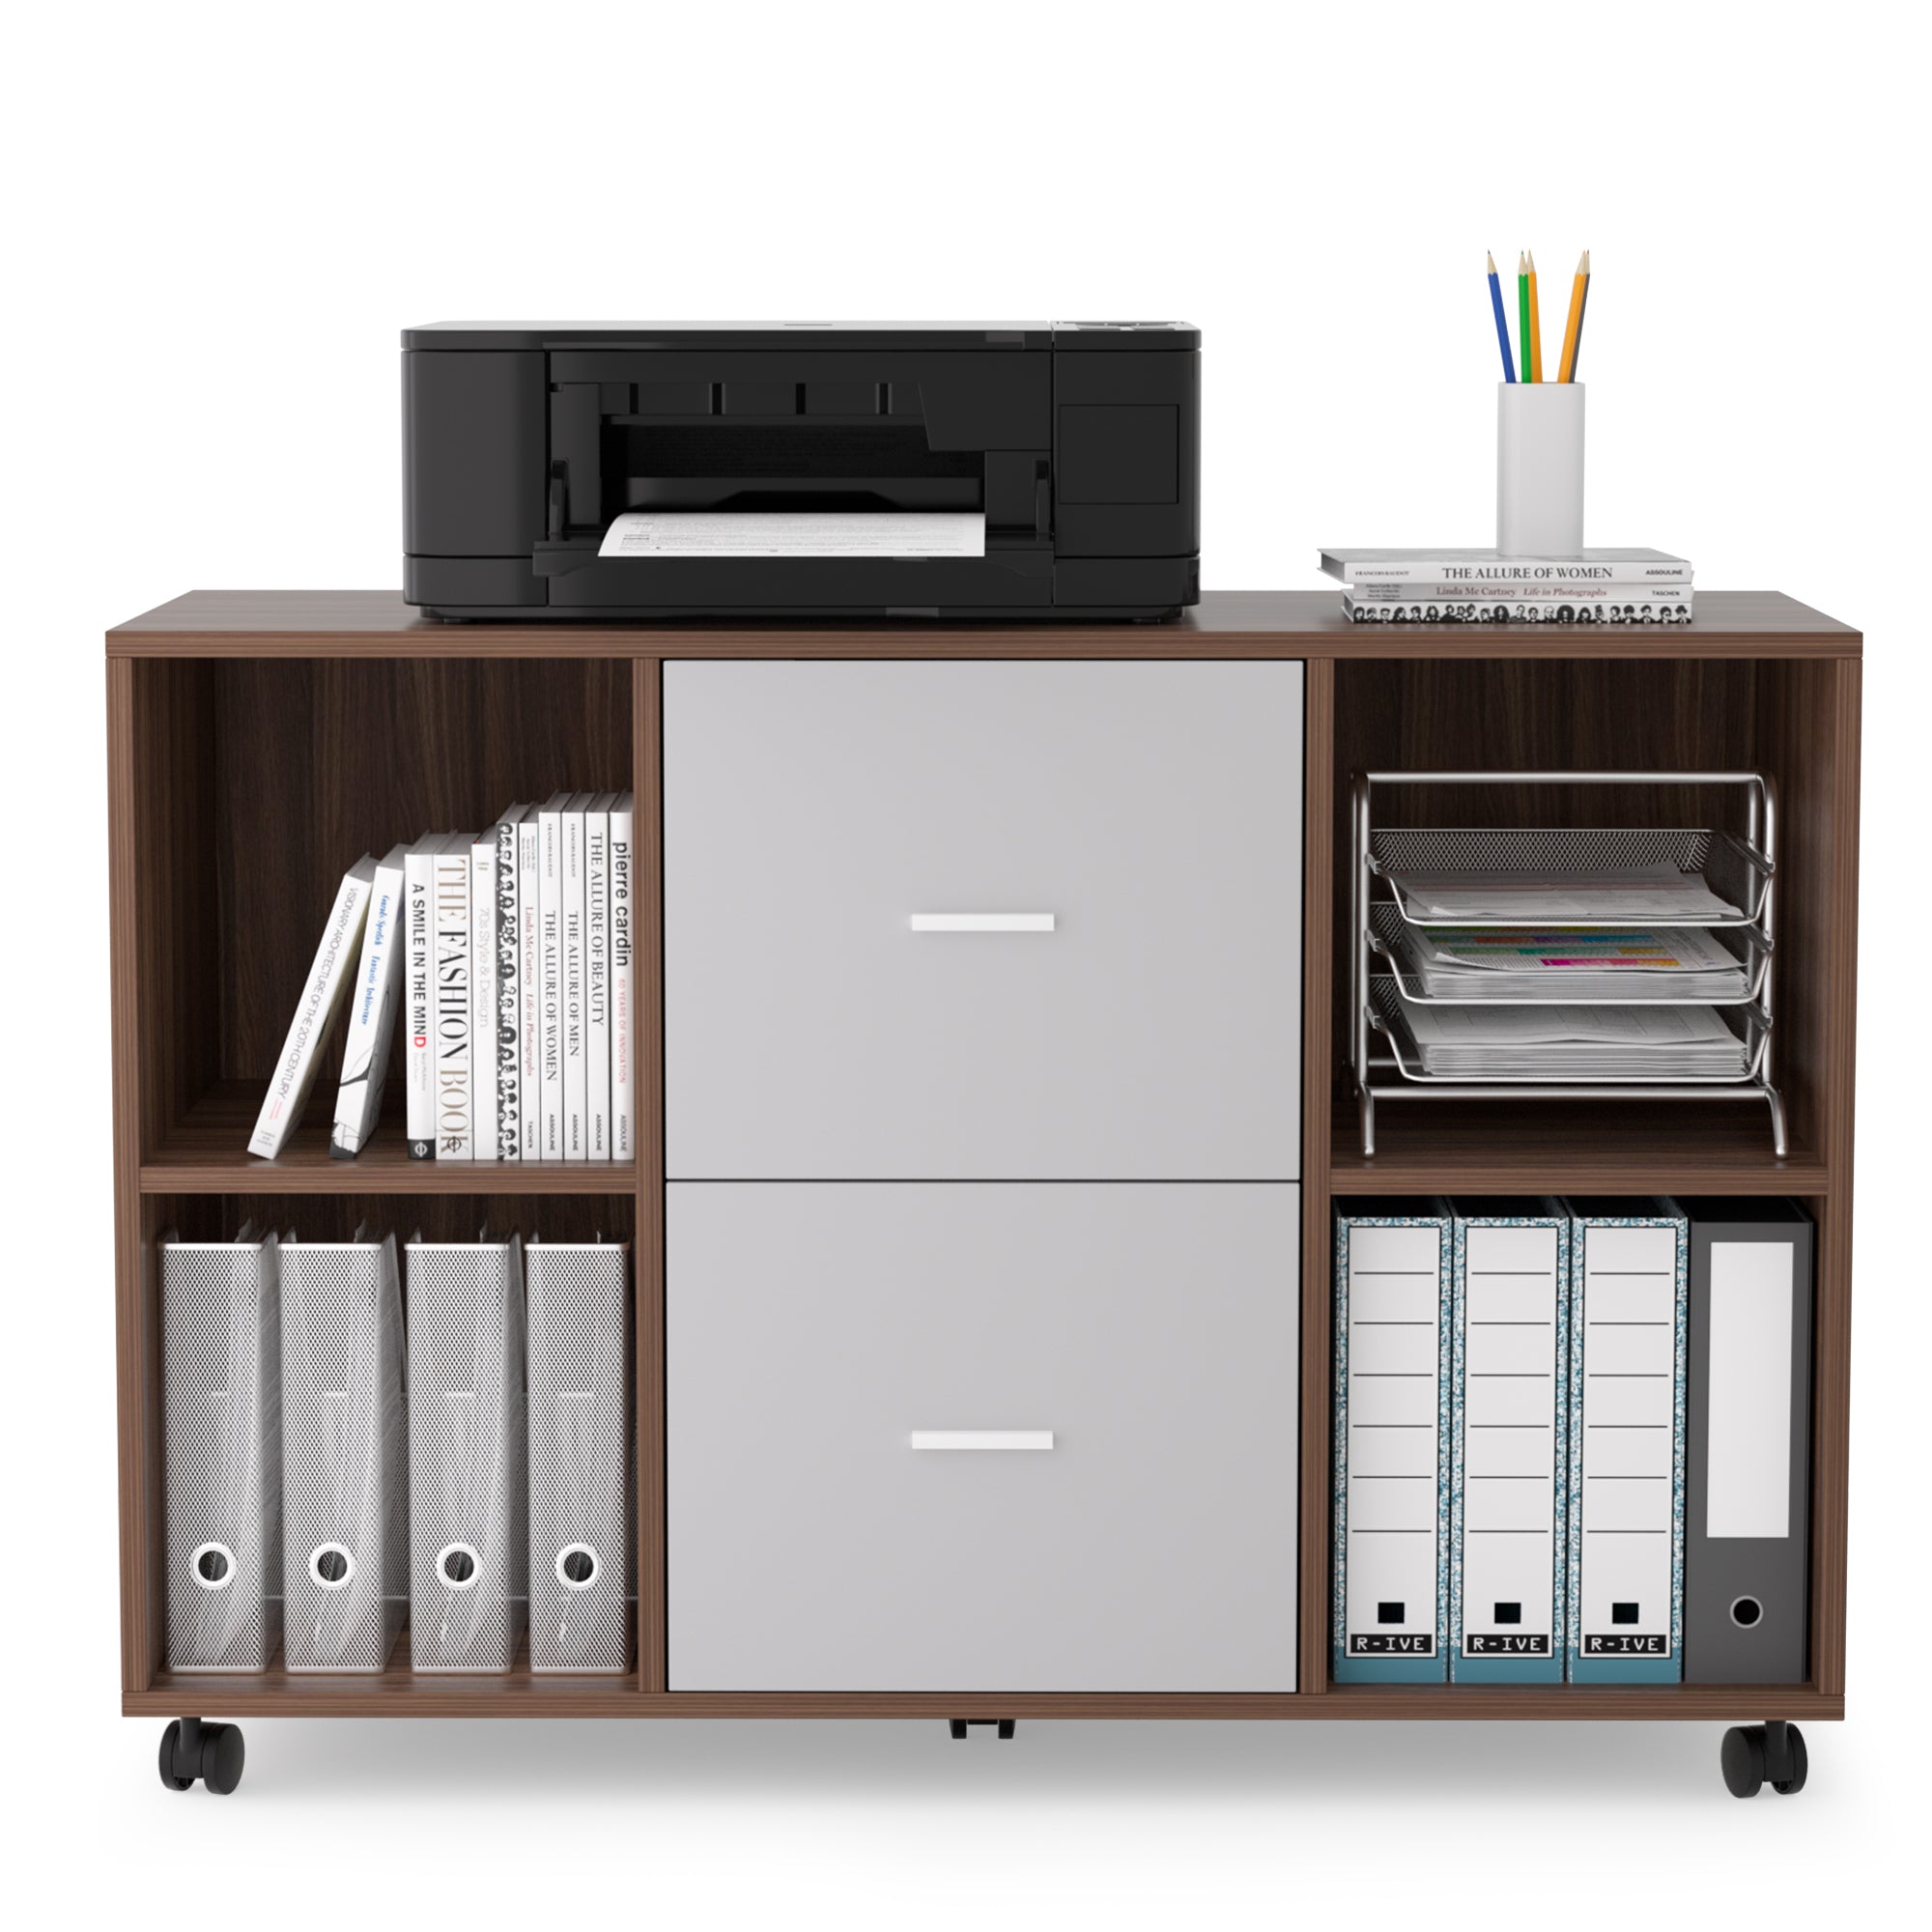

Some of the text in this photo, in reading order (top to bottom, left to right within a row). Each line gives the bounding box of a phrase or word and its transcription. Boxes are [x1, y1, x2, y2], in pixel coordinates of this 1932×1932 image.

[1442, 567, 1613, 580] THE ALLURE OF WOMEN
[1645, 568, 1683, 577] ASSOULINE
[1436, 585, 1517, 598] Linda Mc Cartney
[1523, 586, 1607, 598] Life in Photographs
[412, 883, 425, 895] A
[612, 841, 632, 967] pierre cardin
[412, 898, 426, 947] SMILE
[525, 906, 534, 932] Linda
[590, 832, 605, 1027] THE ALLURE OF BEAUTY
[412, 952, 426, 968] IN
[476, 930, 492, 964] Style
[478, 965, 491, 978] &
[523, 952, 534, 986] Cartney
[568, 910, 580, 1057] THE ALLURE OF MEN
[277, 888, 359, 1099] VISIONARY ARCHITECTURE OF THE 20TH CENTURY
[412, 972, 427, 1001] THE
[545, 910, 557, 1081] THE ALLURE OF WOMEN
[438, 858, 470, 1154] THE FASHION BOOK
[476, 979, 492, 1029] Design
[618, 991, 627, 1018] YEARS
[412, 1006, 428, 1048] MIND
[525, 993, 535, 1077] Life in Photographs
[618, 1019, 627, 1031] OF
[618, 1033, 627, 1084] INNOVATION
[618, 1114, 628, 1152] ASSOULINE
[1356, 1636, 1425, 1652] R-IVE
[1472, 1636, 1541, 1652] R-IVE
[1590, 1636, 1659, 1652] R-IVE
